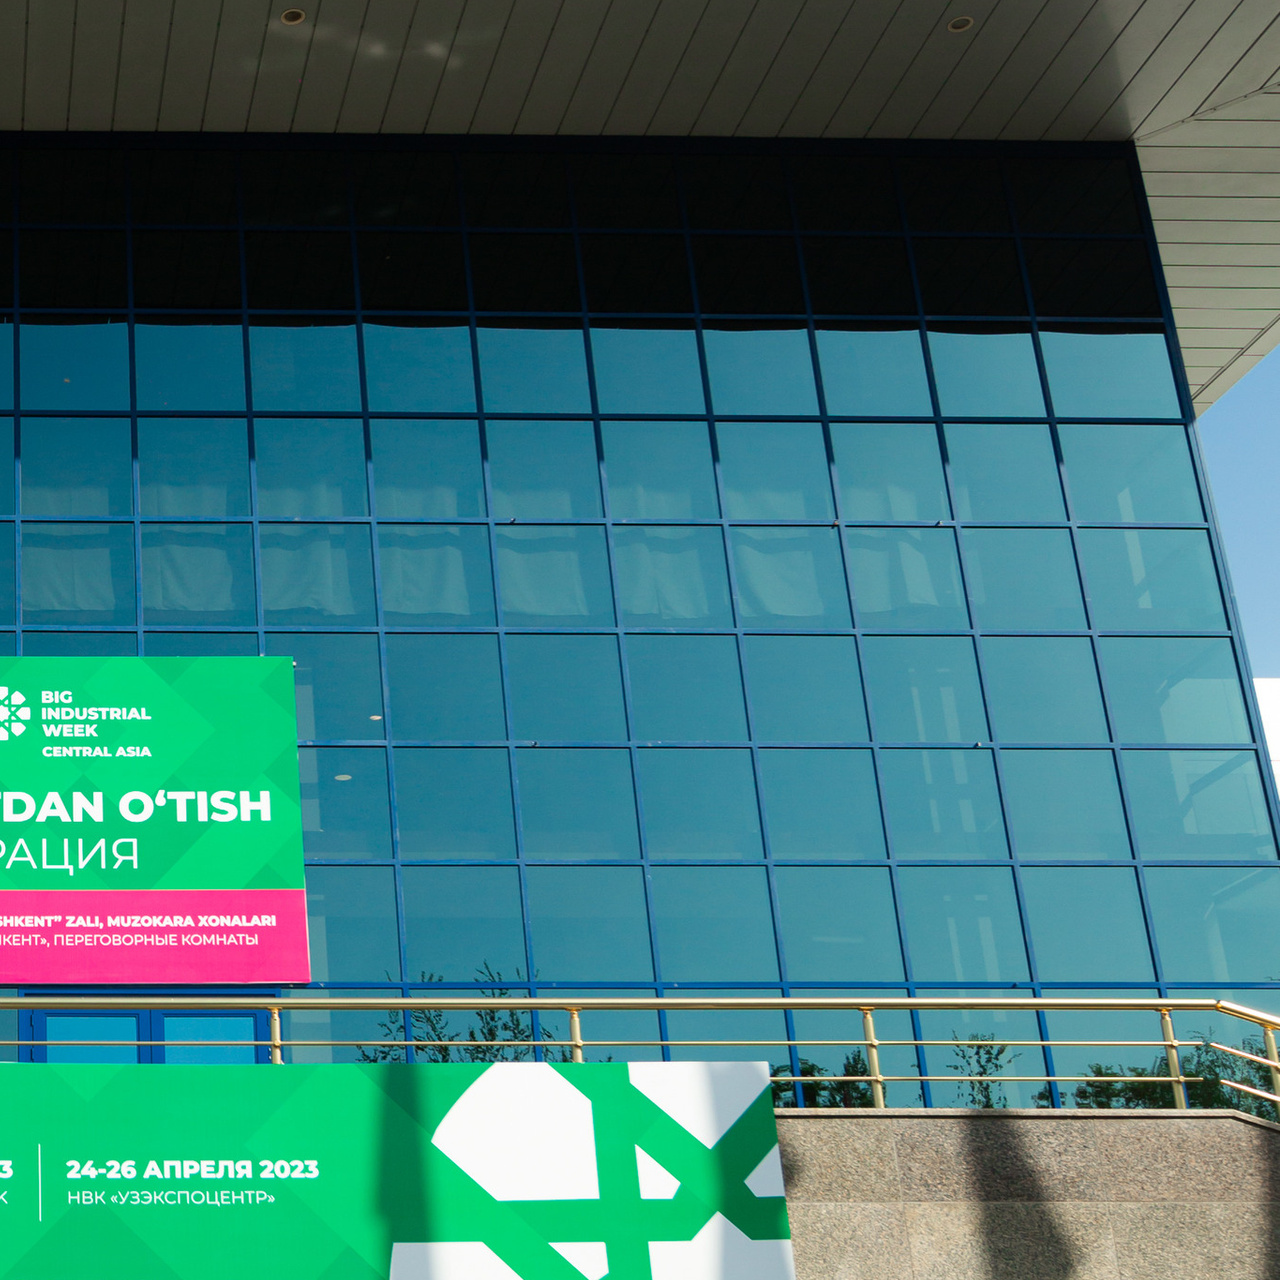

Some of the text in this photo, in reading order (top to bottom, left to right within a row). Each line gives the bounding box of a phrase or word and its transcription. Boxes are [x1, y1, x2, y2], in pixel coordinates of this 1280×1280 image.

[41, 690, 73, 704] BIG
[41, 706, 152, 722] INDUSTRIAL
[41, 723, 99, 738] WEEK
[41, 745, 152, 759] CENTRAL ASIA
[118, 789, 272, 823] O‘TISH
[65, 915, 104, 930] ZALI,
[106, 915, 196, 928] MUZOKARA
[197, 914, 277, 928] XONALARI
[53, 933, 179, 947] ПЕРЕГОВОРНЫЕ
[181, 933, 259, 946] КОМНАТЫ
[65, 1159, 320, 1179] 24-26 АПРЕЛЯ 2023
[67, 1190, 276, 1207] НВК «УЗЭКСПОЦЕНТР»
